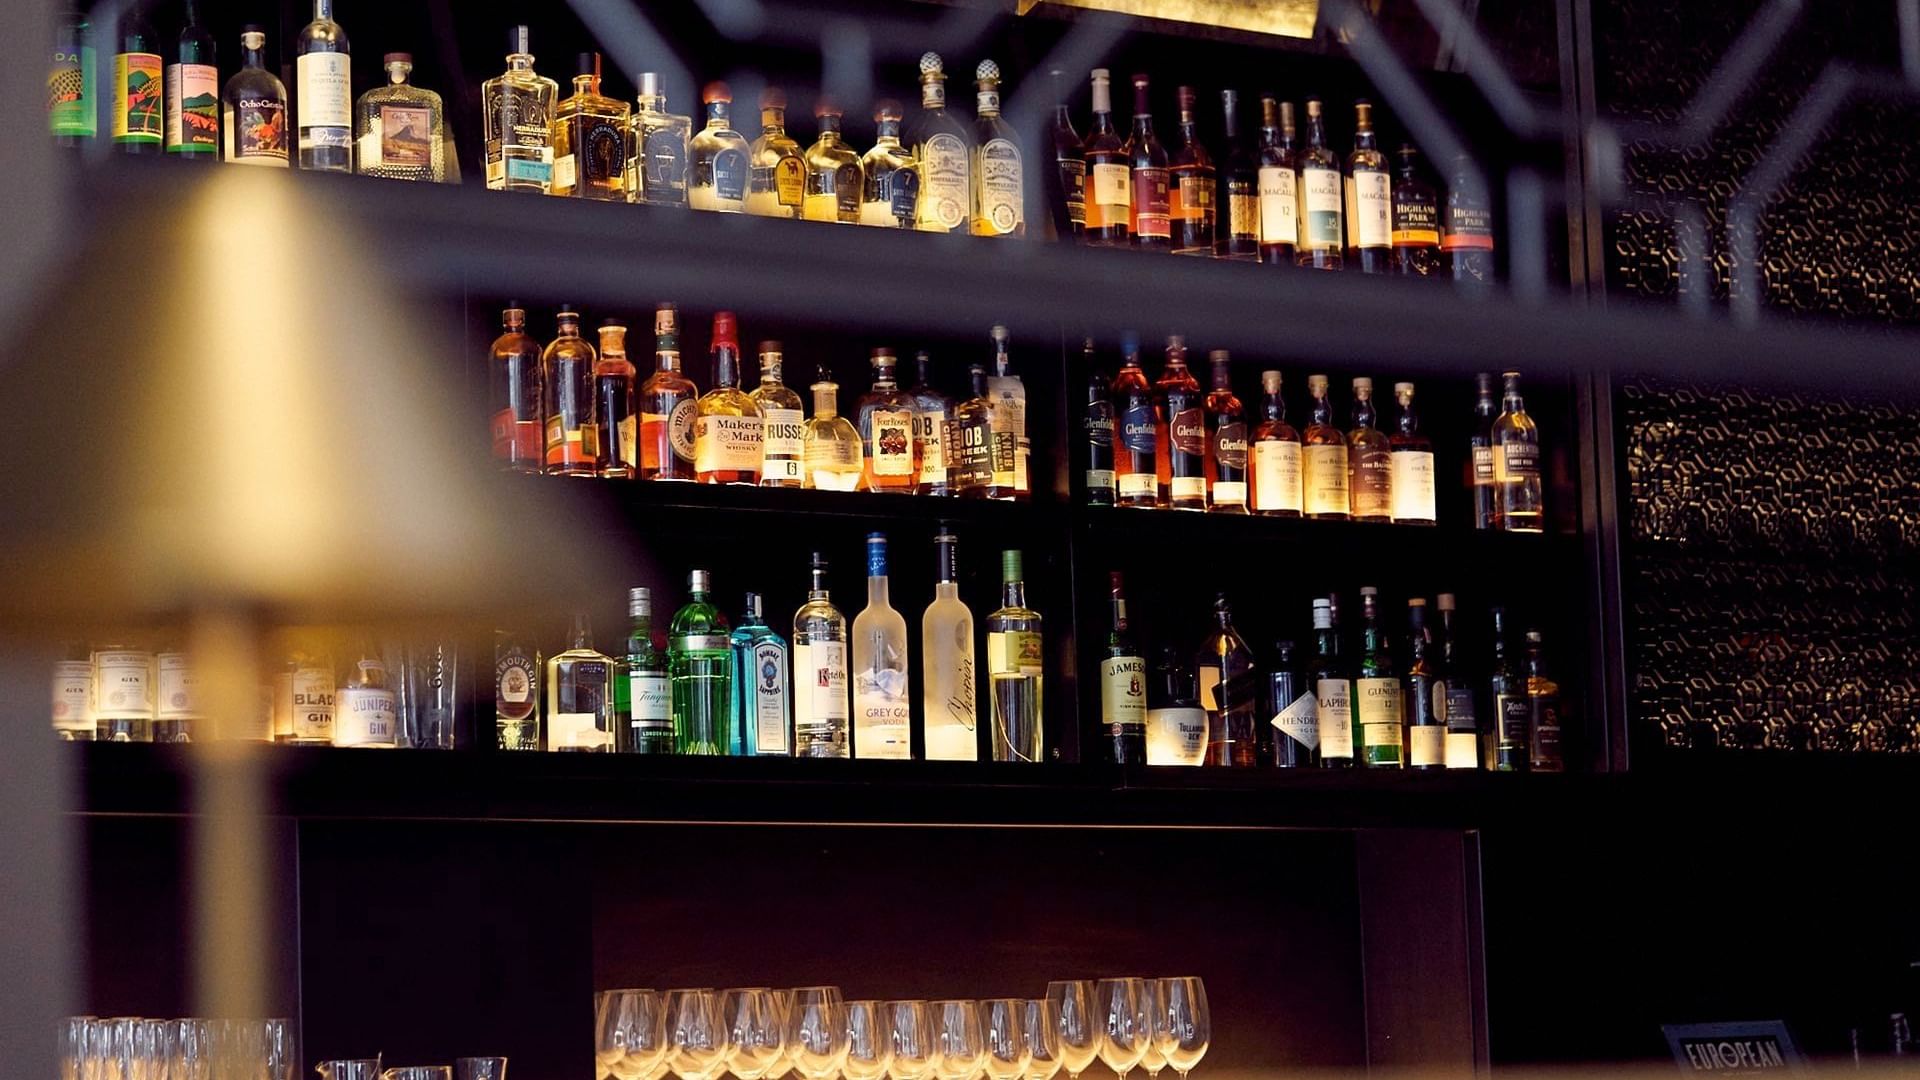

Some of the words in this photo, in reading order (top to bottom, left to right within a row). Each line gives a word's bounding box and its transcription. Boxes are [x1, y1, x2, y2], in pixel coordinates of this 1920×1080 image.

[1396, 203, 1436, 214] HIGHLAND
[1408, 213, 1428, 222] PARK
[1464, 217, 1485, 226] PARK
[716, 418, 764, 431] Maker's
[730, 430, 764, 442] Mark
[943, 425, 953, 465] CREEK
[1001, 432, 1013, 467] KNOB
[1143, 480, 1151, 489] 14
[758, 648, 780, 661] BOMBAY
[527, 669, 536, 689] GIN
[758, 685, 782, 696] SAPPHIRE
[946, 657, 975, 732] Chopin
[1384, 699, 1392, 708] 12
[307, 712, 332, 723] GIN
[866, 707, 890, 718] GREY
[369, 722, 388, 735] GIN
[1685, 1040, 1785, 1070] EUROPEAN
